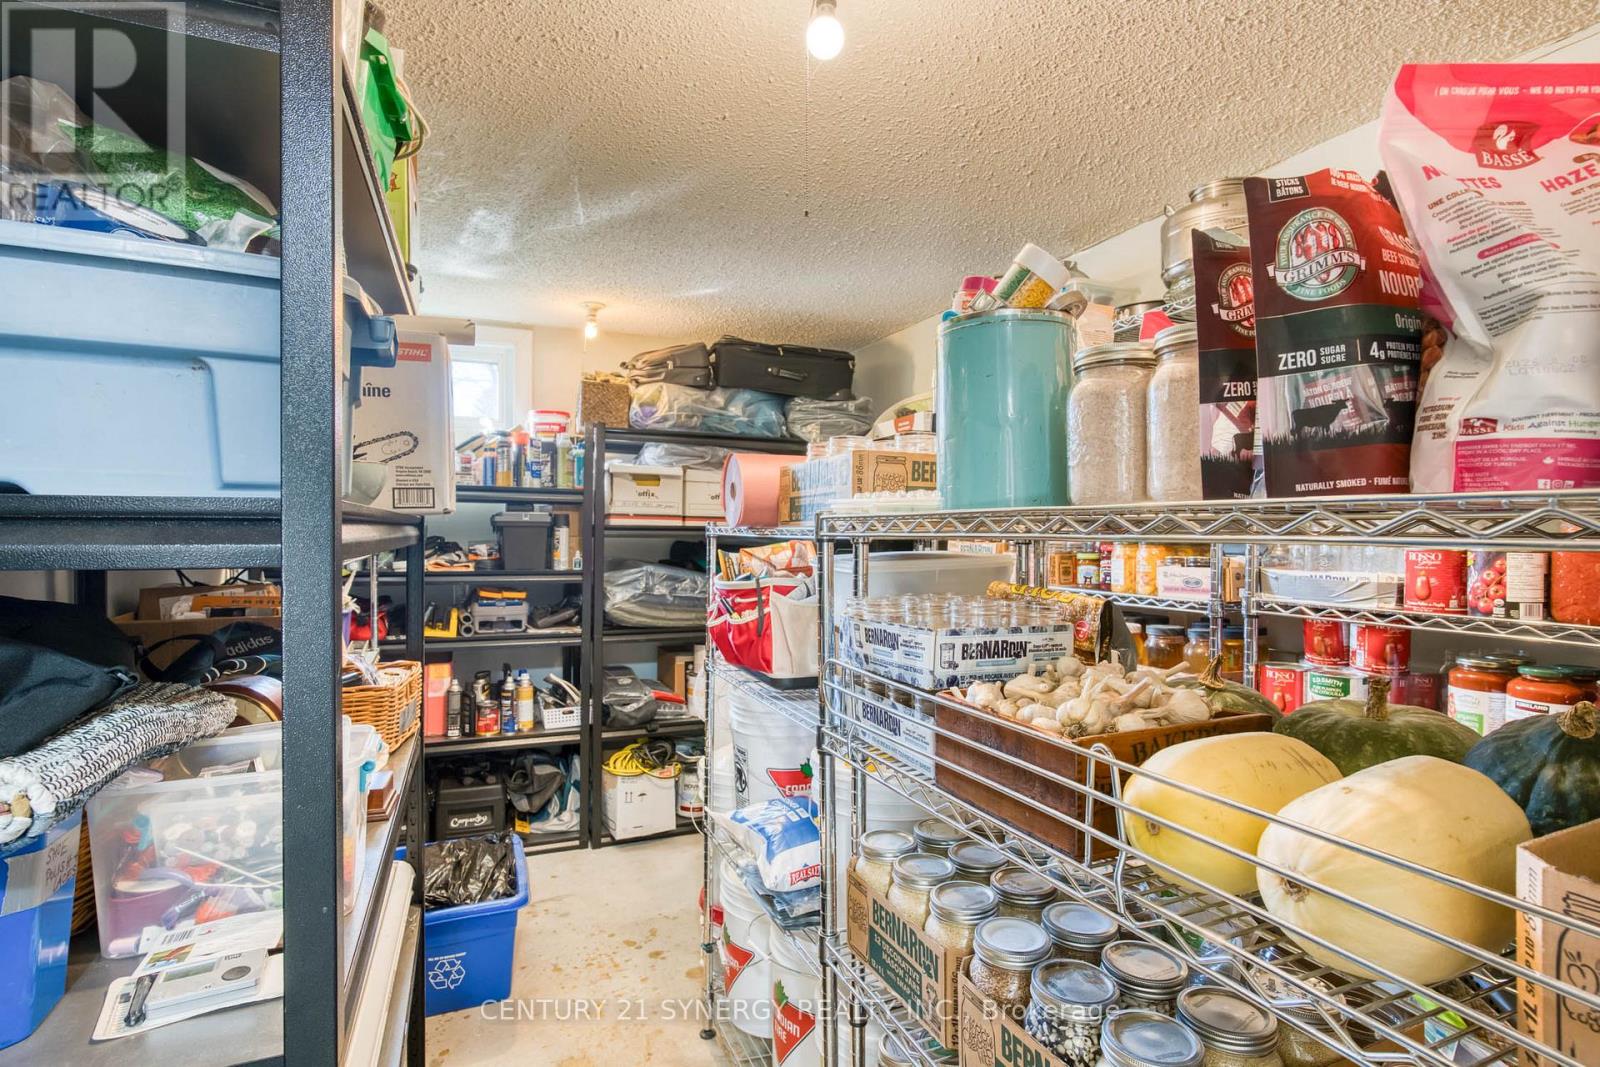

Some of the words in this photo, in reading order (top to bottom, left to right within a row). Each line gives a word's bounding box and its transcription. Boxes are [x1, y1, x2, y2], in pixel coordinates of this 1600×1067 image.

[1481, 148, 1534, 168] BASSÉ
[1275, 177, 1301, 187] STICKS
[1275, 184, 1305, 198] BÂTONS
[1284, 251, 1356, 282] GRIMM'S
[1278, 349, 1317, 371] ZERO
[1319, 344, 1346, 356] SUGAR
[1320, 353, 1346, 365] SUCRE
[1223, 381, 1251, 398] ZERO
[1295, 481, 1334, 492] NATURALLY
[1335, 478, 1367, 489] SMOKED
[1408, 551, 1442, 561] ROSSO
[226, 634, 275, 657] adidas
[864, 627, 899, 650] BERNARDIN
[961, 639, 1028, 661] BERNARDIN
[1265, 669, 1295, 681] ROSSO
[862, 702, 901, 737] BERNARDIN
[872, 897, 939, 984] BERNARDIN
